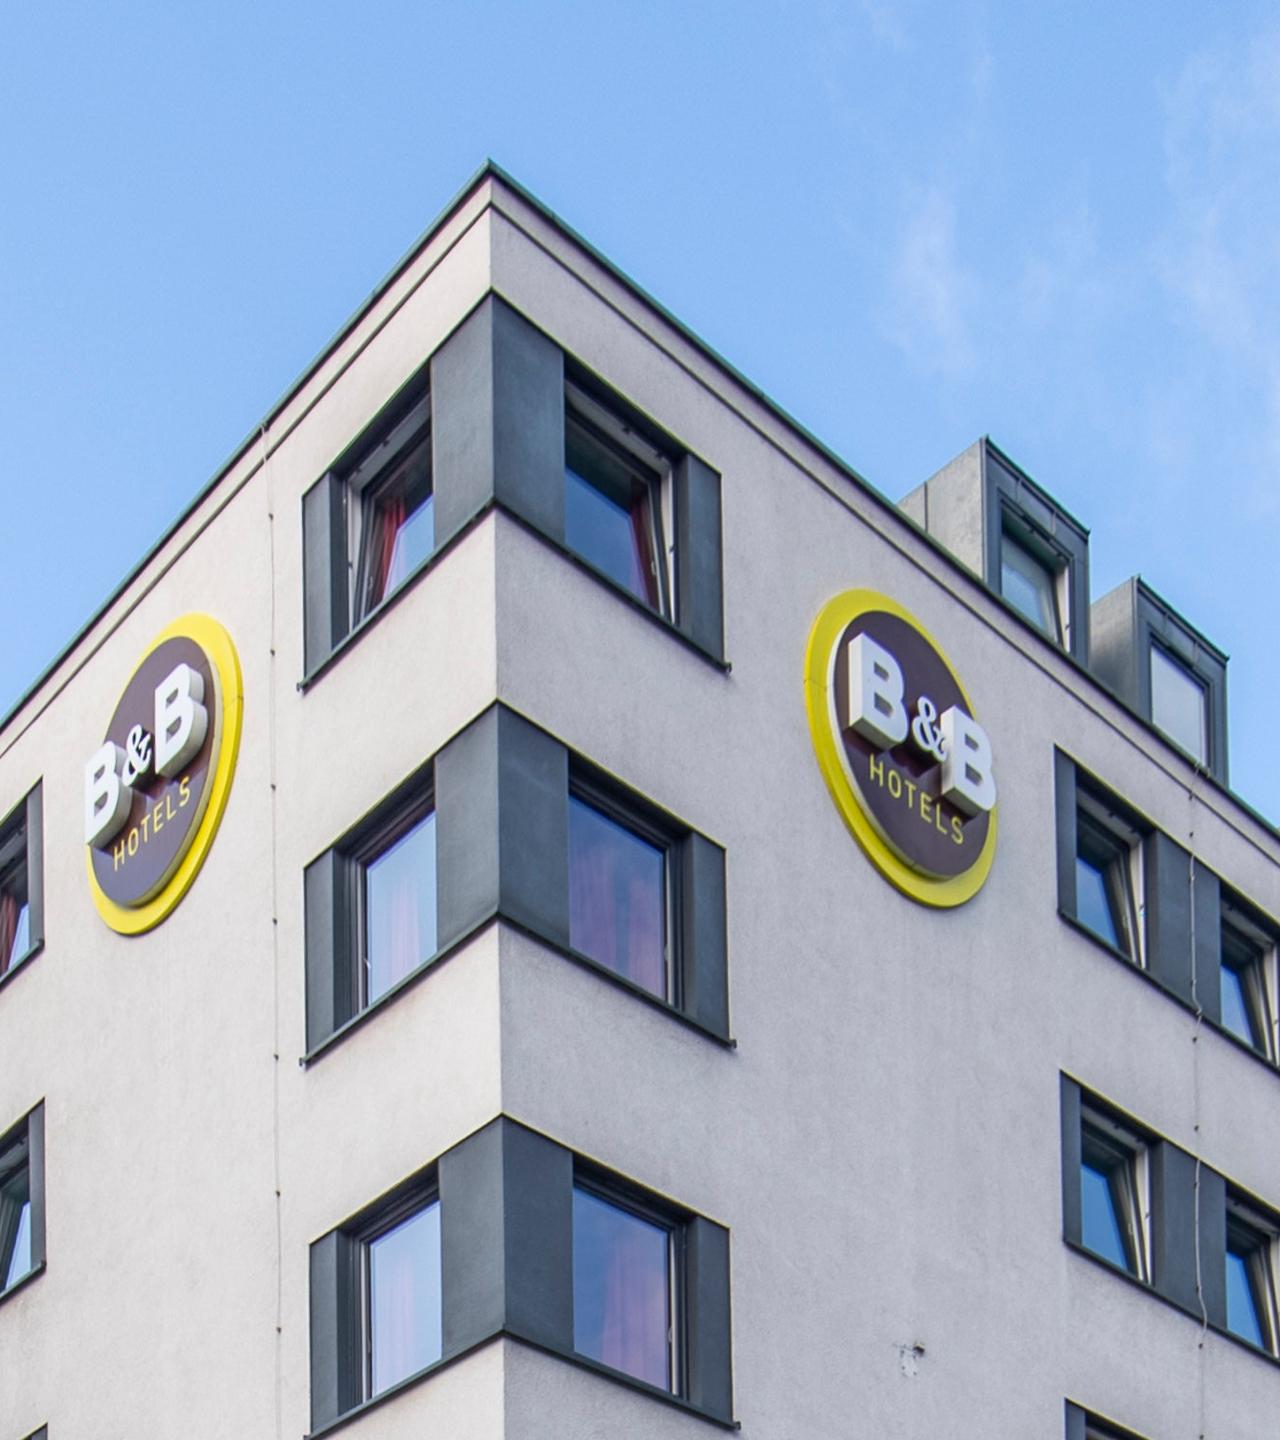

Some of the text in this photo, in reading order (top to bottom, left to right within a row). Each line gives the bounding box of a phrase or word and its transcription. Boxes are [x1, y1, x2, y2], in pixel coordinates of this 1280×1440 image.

[85, 663, 207, 848] B&B
[848, 632, 996, 811] B&B
[113, 776, 191, 871] HOTELS
[869, 754, 964, 844] HOTELS
